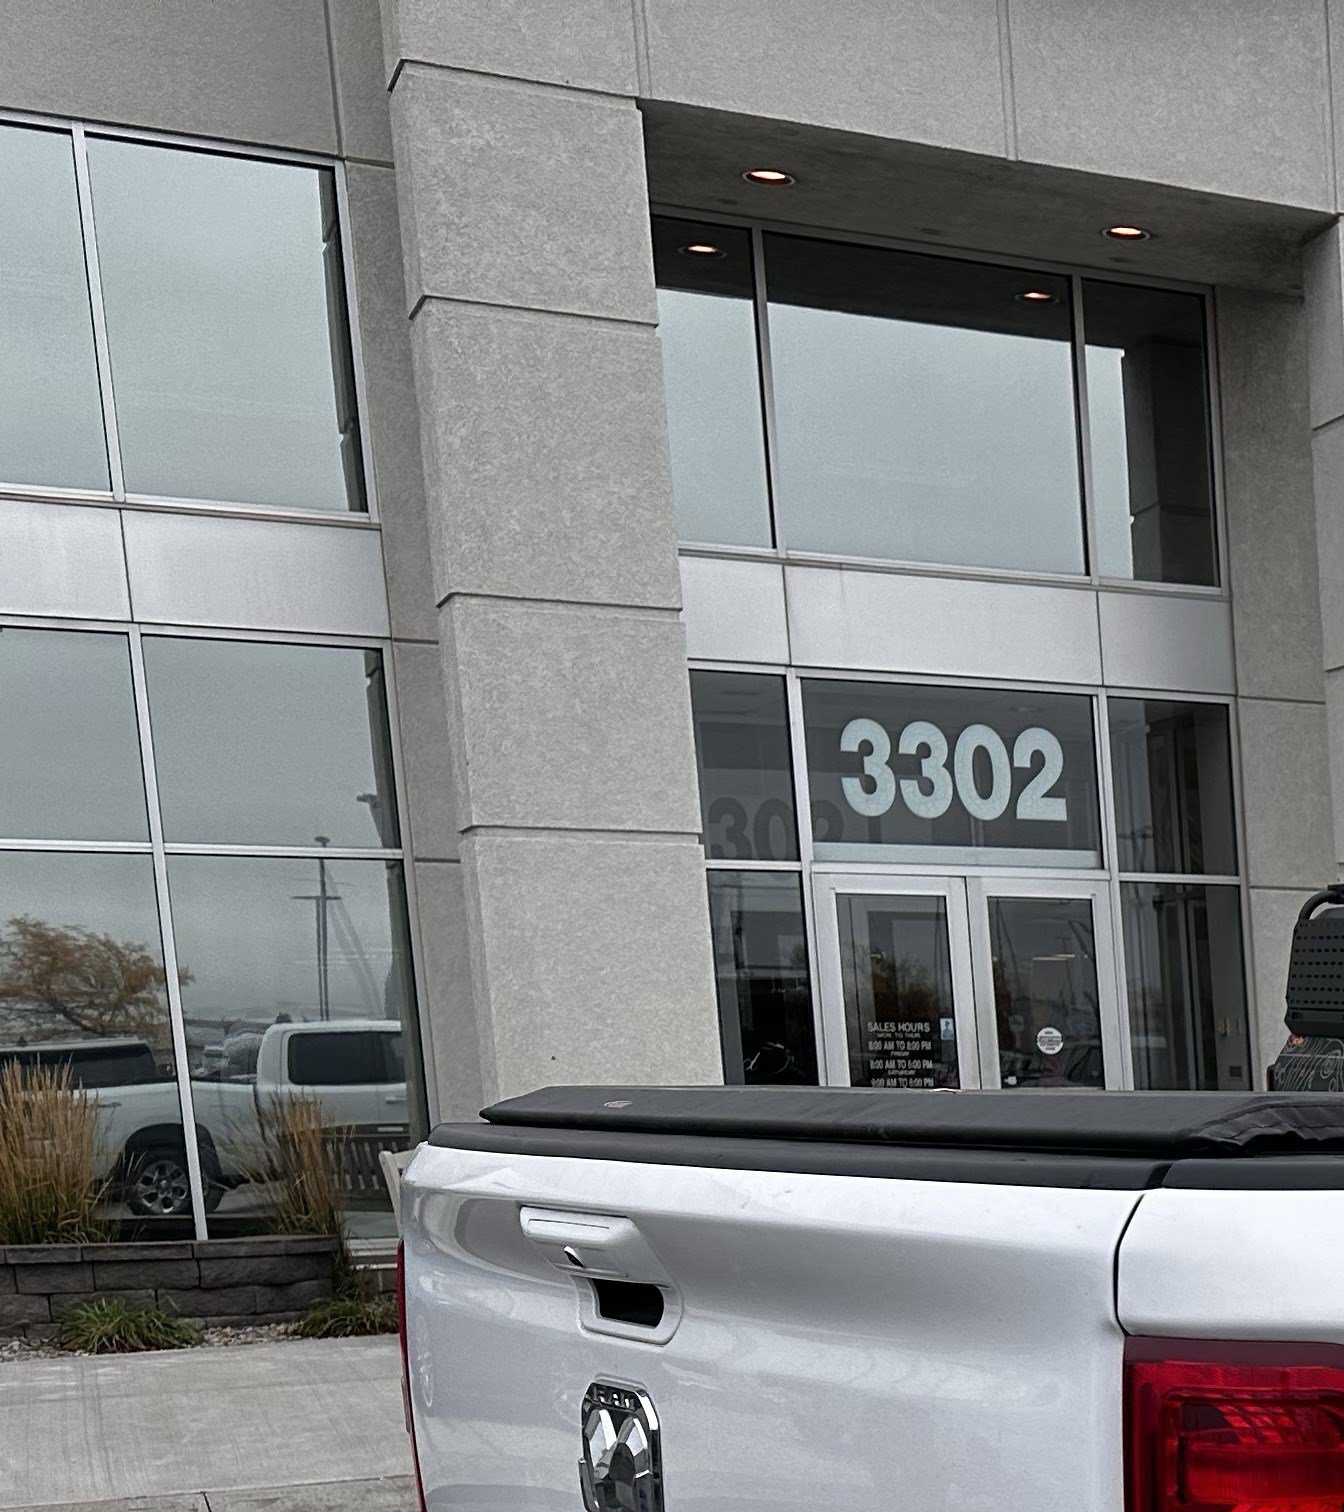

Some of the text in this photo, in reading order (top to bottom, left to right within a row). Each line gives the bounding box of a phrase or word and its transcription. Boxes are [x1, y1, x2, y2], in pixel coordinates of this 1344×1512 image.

[840, 717, 1067, 822] 3302
[867, 1021, 931, 1033] SALES HOURS
[883, 1040, 895, 1050] AM
[896, 1040, 906, 1050] TO
[921, 1040, 932, 1050] PM
[884, 1059, 896, 1069] AM
[897, 1059, 907, 1069] TO
[922, 1059, 933, 1069] PM
[886, 1078, 897, 1088] AM
[898, 1078, 908, 1088] TO
[923, 1078, 935, 1088] PM
[592, 1384, 636, 1411] RAM
